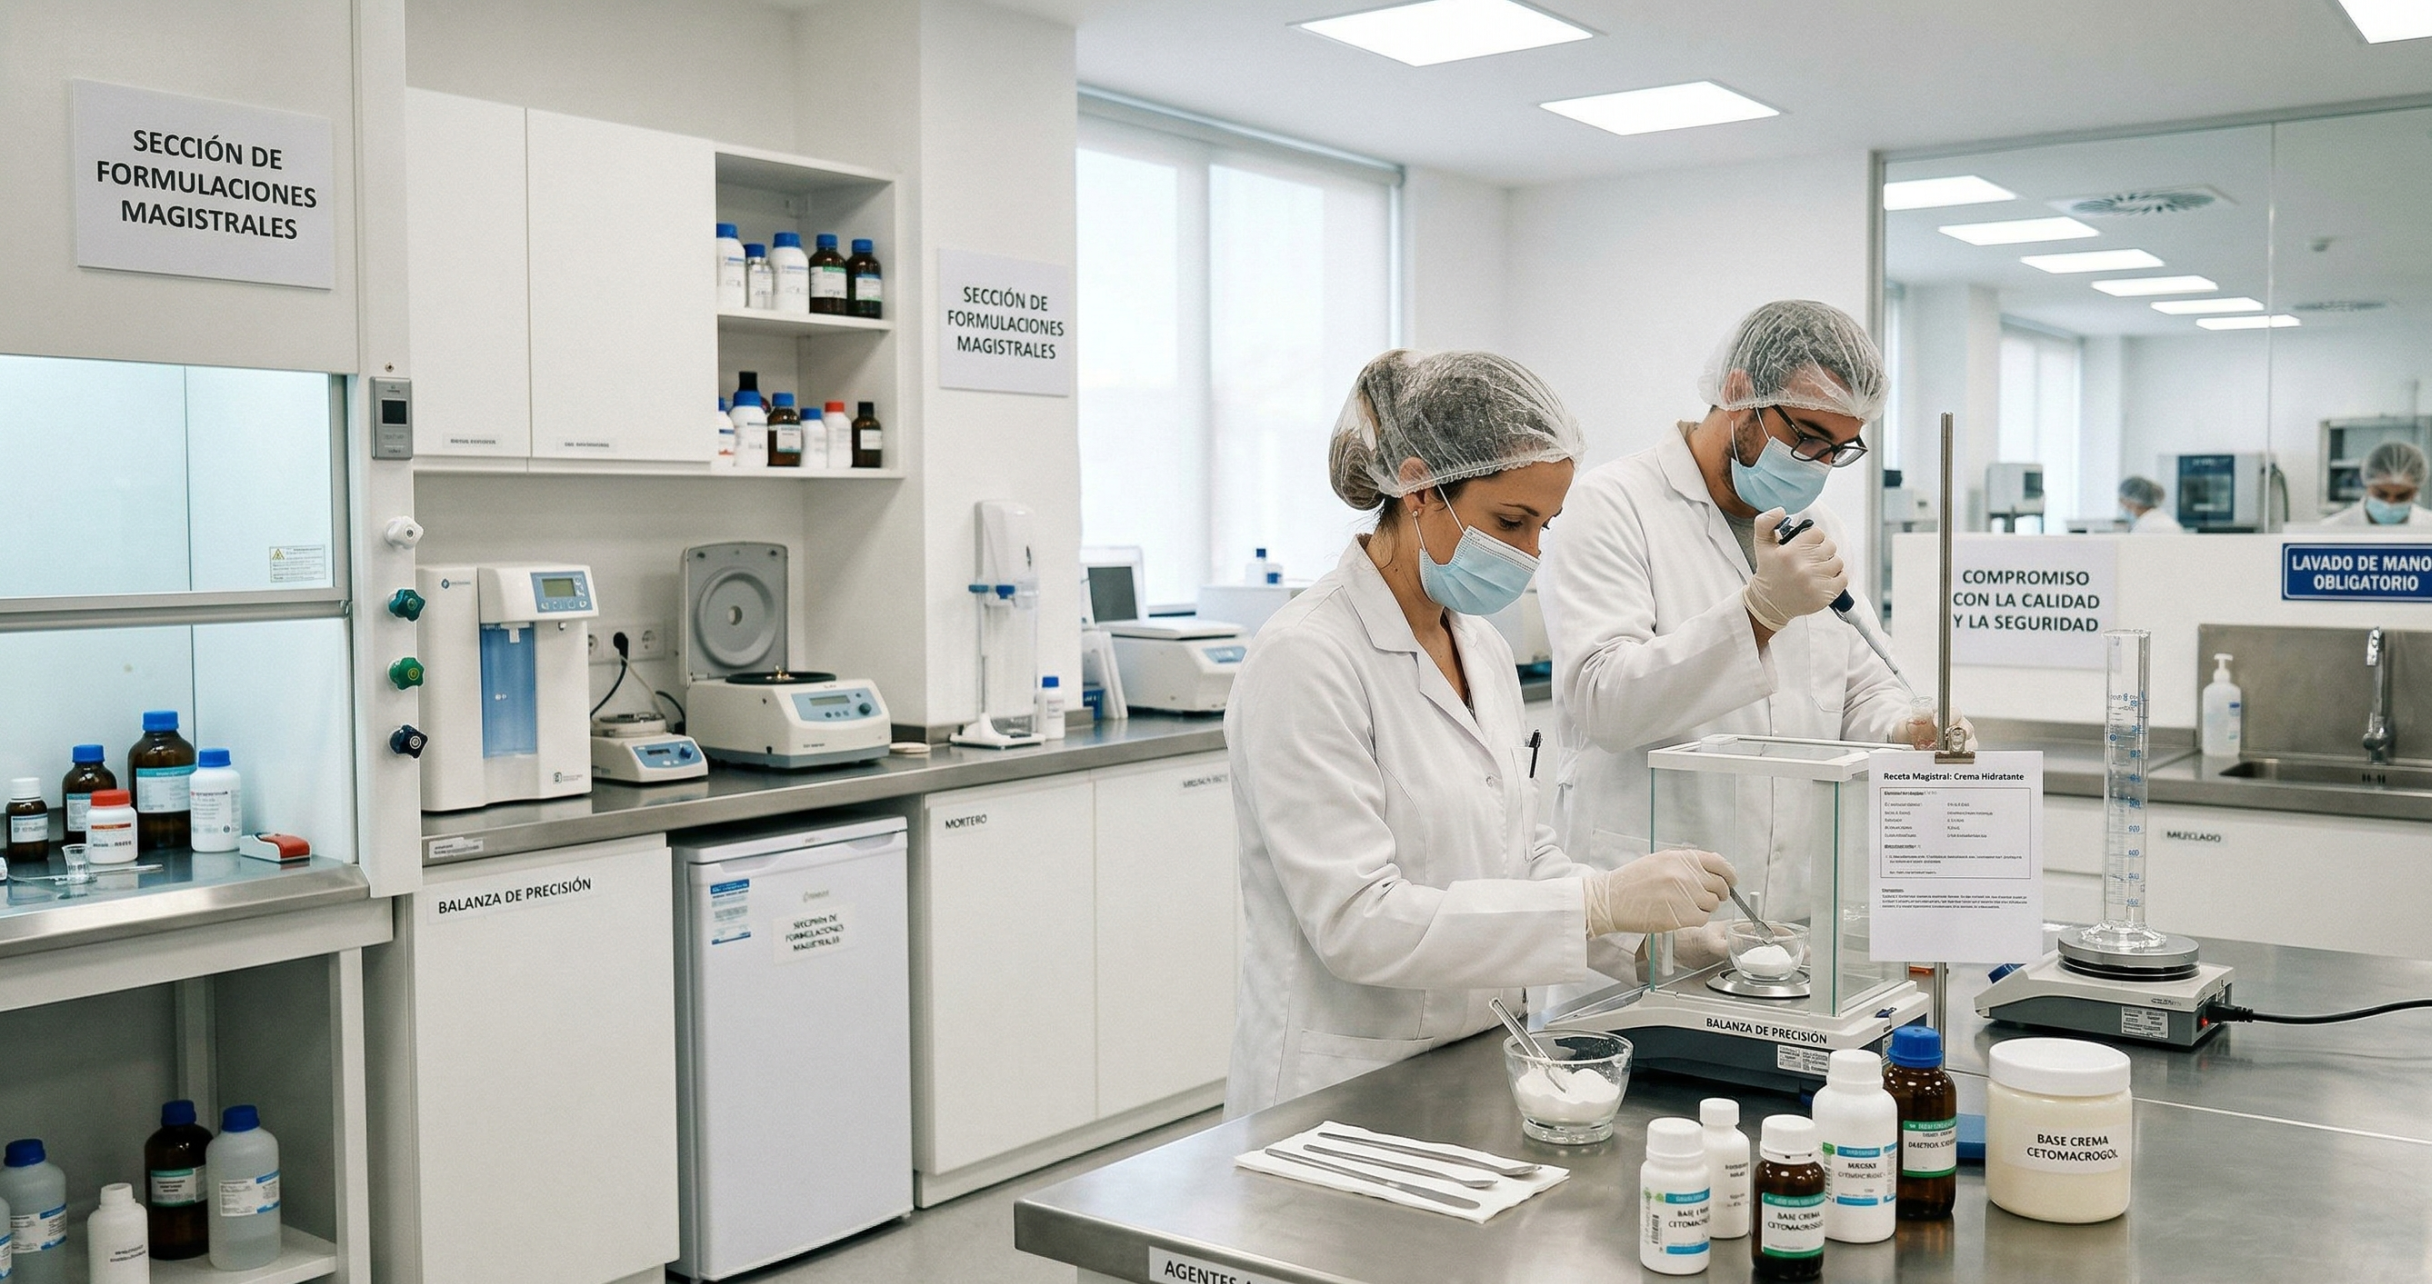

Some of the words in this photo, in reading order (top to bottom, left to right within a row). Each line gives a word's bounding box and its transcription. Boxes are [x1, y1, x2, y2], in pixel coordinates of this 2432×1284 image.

[133, 129, 243, 165] SECCIÓN
[251, 146, 283, 170] DE
[97, 160, 317, 208] FORMULACIONES
[121, 200, 298, 240] MAGISTRALES
[963, 286, 1026, 309] SECCIÓN
[1030, 294, 1048, 312] DE
[947, 310, 1064, 337] FORMULACIONES
[957, 335, 1056, 360] MAGISTRALES
[2292, 555, 2353, 571] LAVADO
[2357, 555, 2379, 571] DE
[2382, 555, 2432, 572] MANO
[1962, 569, 2090, 586] COMPROMISO
[2313, 574, 2419, 591] OBLIGATORIO
[1952, 592, 1990, 607] CON
[1995, 593, 2017, 607] LA
[2021, 593, 2100, 609] CALIDAD
[1952, 614, 1963, 629] Y
[1968, 615, 1989, 629] LA
[1994, 615, 2099, 632] SEGURIDAD
[1883, 772, 1911, 781] Receta
[1912, 772, 1952, 782] Magistral:
[1953, 772, 1980, 781] Crema
[1981, 772, 2025, 781] Hidratante
[438, 892, 502, 915] BALANZA
[505, 889, 523, 904] DE
[526, 875, 592, 900] PRECISIÓN
[1706, 1018, 1753, 1034] BALANZA
[1755, 1025, 1769, 1036] DE
[1771, 1027, 1827, 1044] PRECISIÓN
[2037, 1133, 2067, 1147] BASE
[2070, 1135, 2109, 1147] CREMA
[2026, 1146, 2118, 1161] CETOMACROGOL
